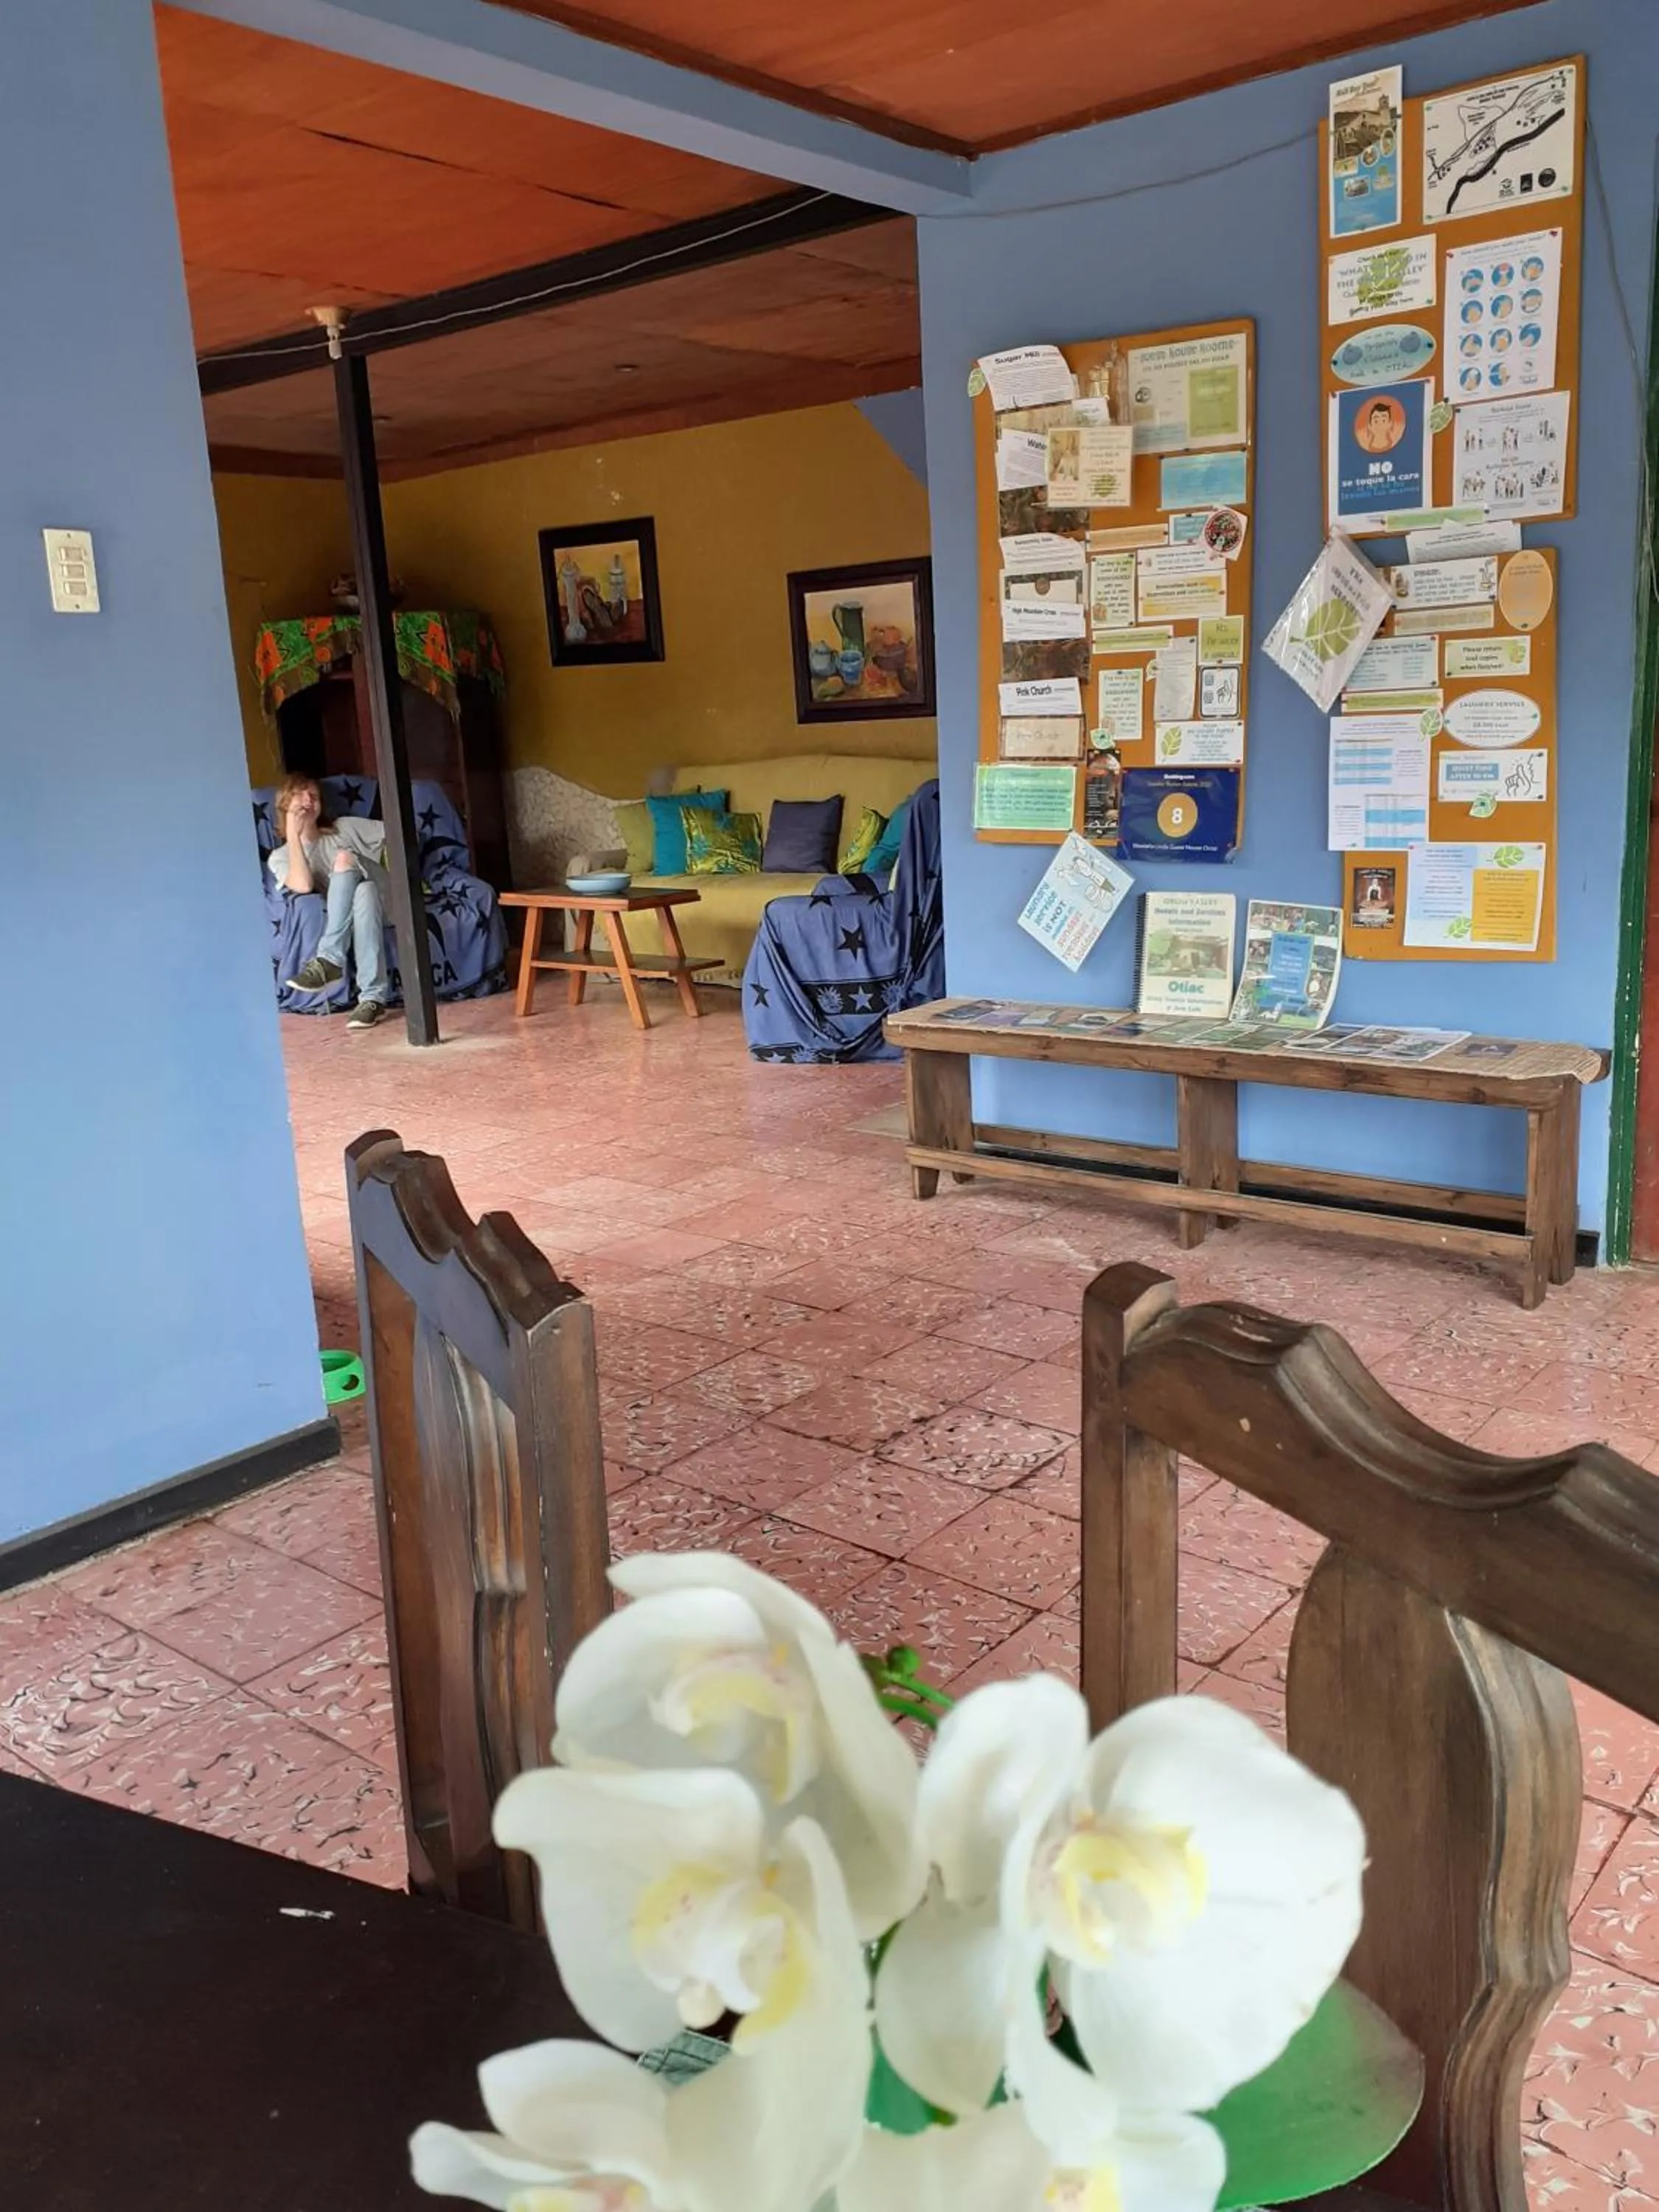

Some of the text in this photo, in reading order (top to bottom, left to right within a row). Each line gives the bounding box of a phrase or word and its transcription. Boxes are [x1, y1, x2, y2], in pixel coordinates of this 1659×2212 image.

[995, 355, 1022, 364] Sugar
[1368, 462, 1393, 476] NO
[1356, 477, 1384, 486] toque
[1387, 474, 1396, 482] la
[1398, 473, 1419, 481] cara
[1016, 685, 1051, 695] Pink Church
[1172, 808, 1183, 824] 8
[1050, 900, 1067, 923] NOT
[1168, 981, 1204, 993] Otiac
